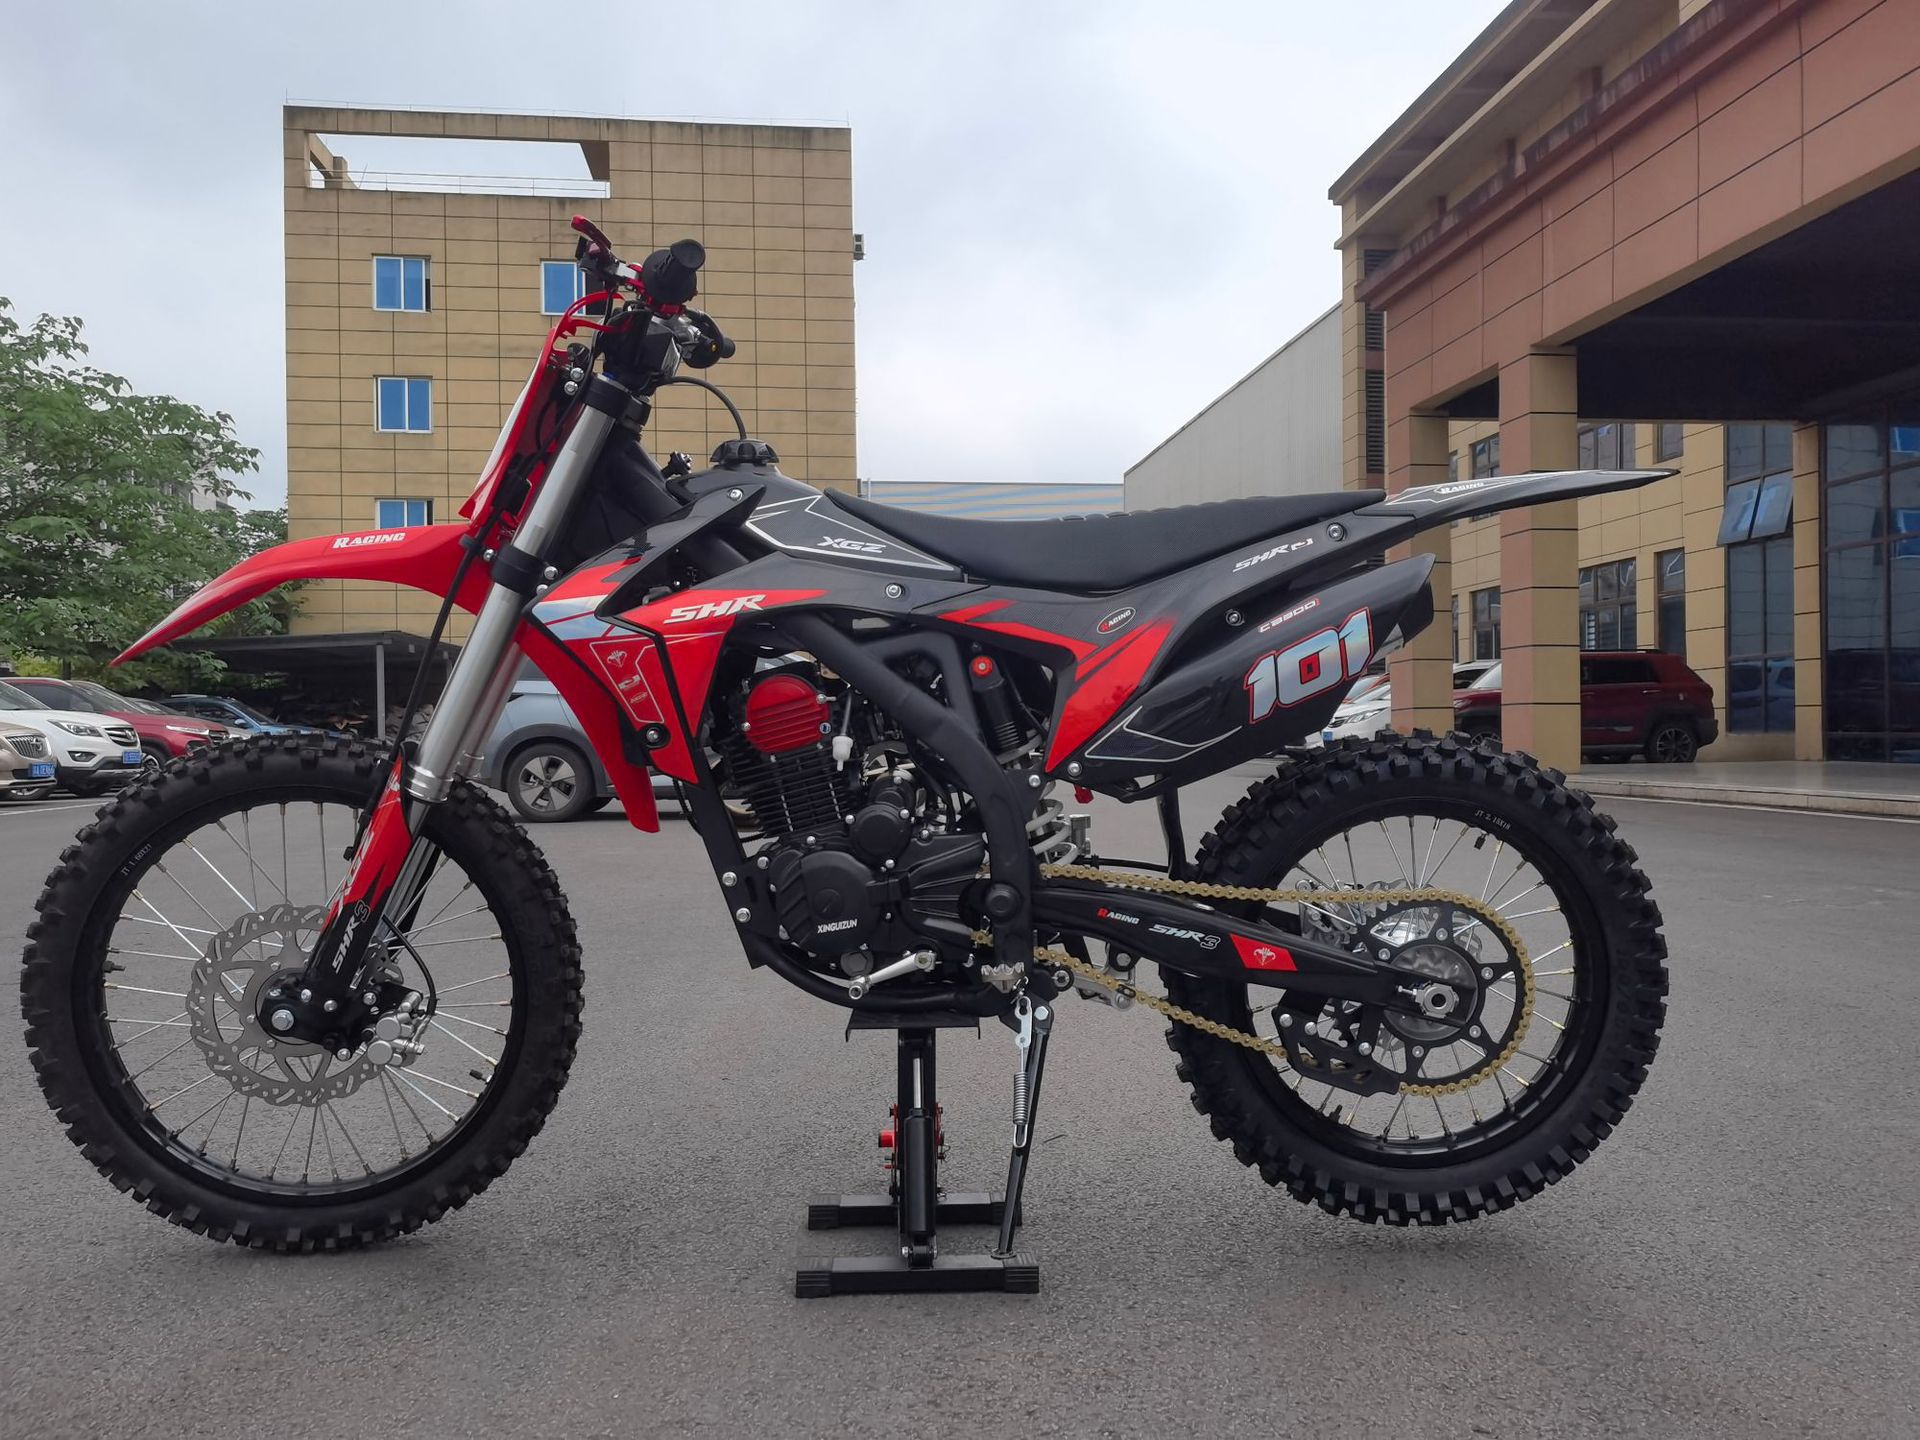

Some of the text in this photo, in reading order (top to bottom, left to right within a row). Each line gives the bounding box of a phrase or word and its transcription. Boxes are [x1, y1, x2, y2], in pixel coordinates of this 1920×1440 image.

[332, 533, 406, 548] RACING
[817, 536, 887, 554] XGZ
[664, 594, 766, 624] SHR
[1243, 606, 1374, 724] 101
[1097, 907, 1140, 925] RACING
[817, 918, 858, 934] XINGUIZUN
